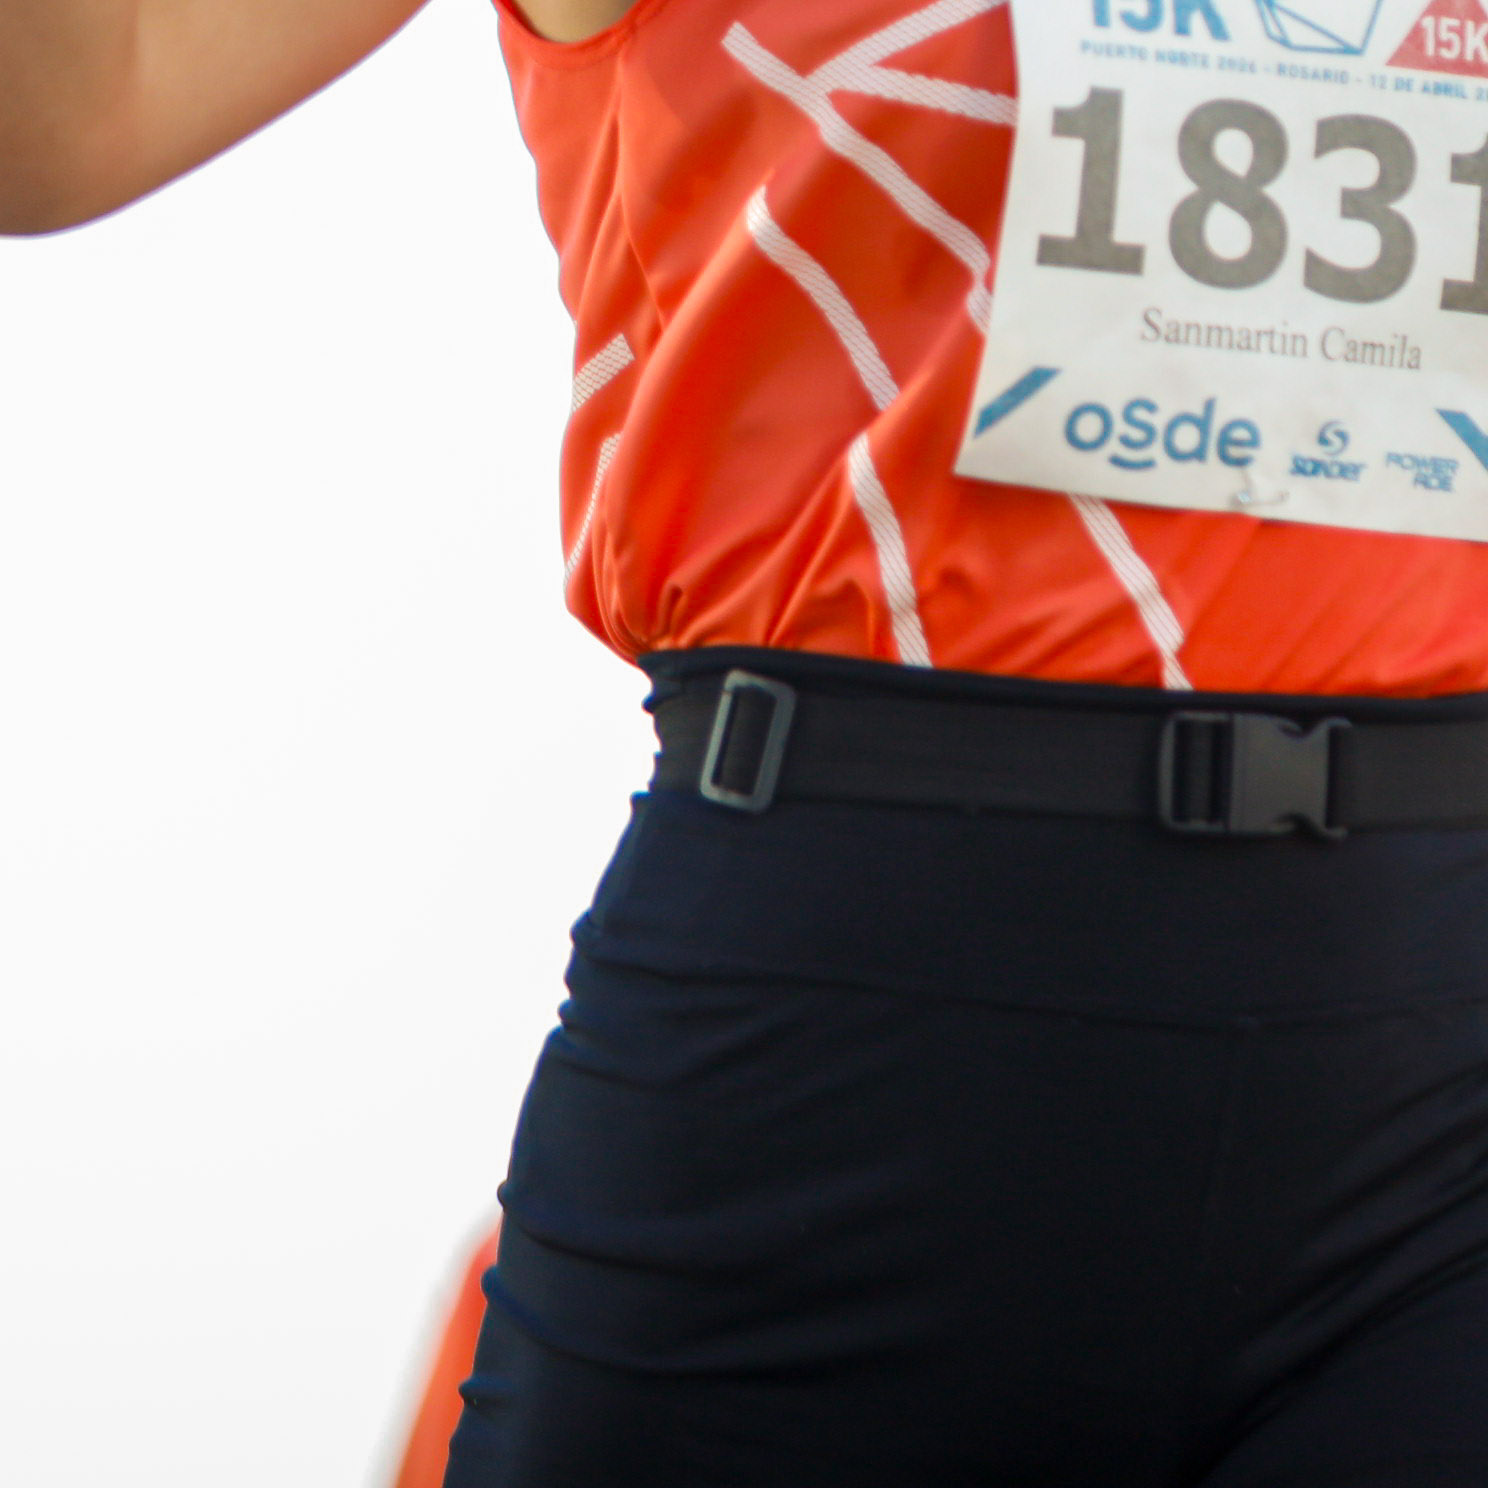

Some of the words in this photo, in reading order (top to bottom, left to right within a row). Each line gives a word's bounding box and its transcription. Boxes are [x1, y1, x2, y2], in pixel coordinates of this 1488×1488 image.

[1080, 40, 1148, 61] PUERTO
[1154, 49, 1209, 69] NORTE
[1277, 61, 1350, 85] ROSARIO
[1370, 73, 1388, 90] 12
[1394, 75, 1414, 92] DE
[1420, 79, 1468, 101] ABRIL
[1139, 307, 1308, 358] Sanmartin
[1319, 325, 1423, 371] Camila
[1063, 396, 1261, 470] osde
